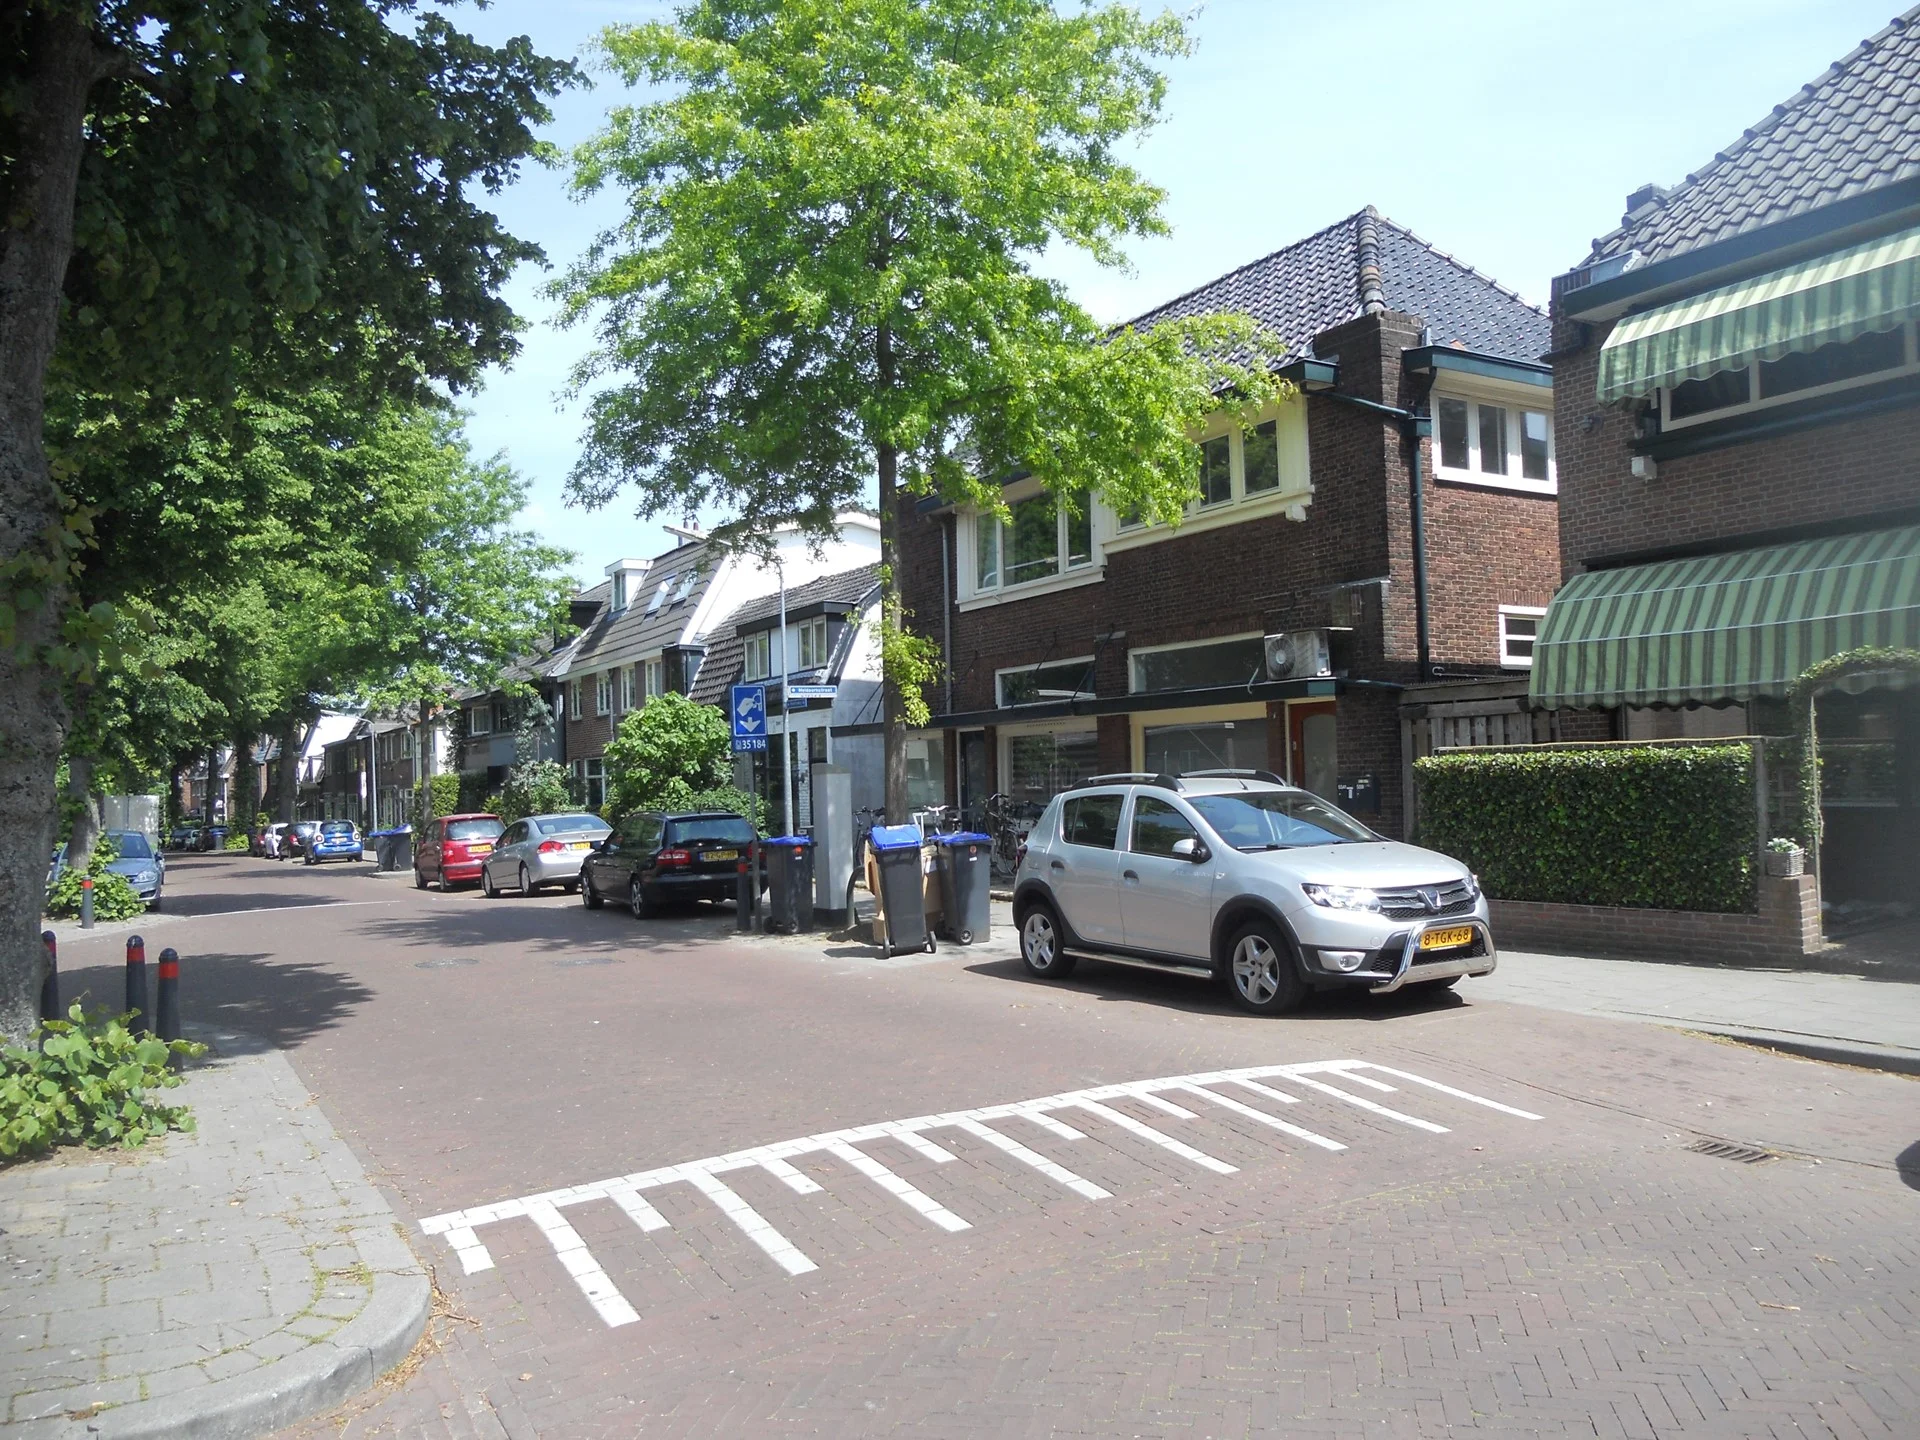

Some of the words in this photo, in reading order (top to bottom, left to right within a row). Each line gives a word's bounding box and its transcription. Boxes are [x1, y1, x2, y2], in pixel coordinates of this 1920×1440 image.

[741, 740, 751, 749] 35
[753, 740, 766, 748] 184
[1424, 929, 1469, 945] 8-TGK-68
